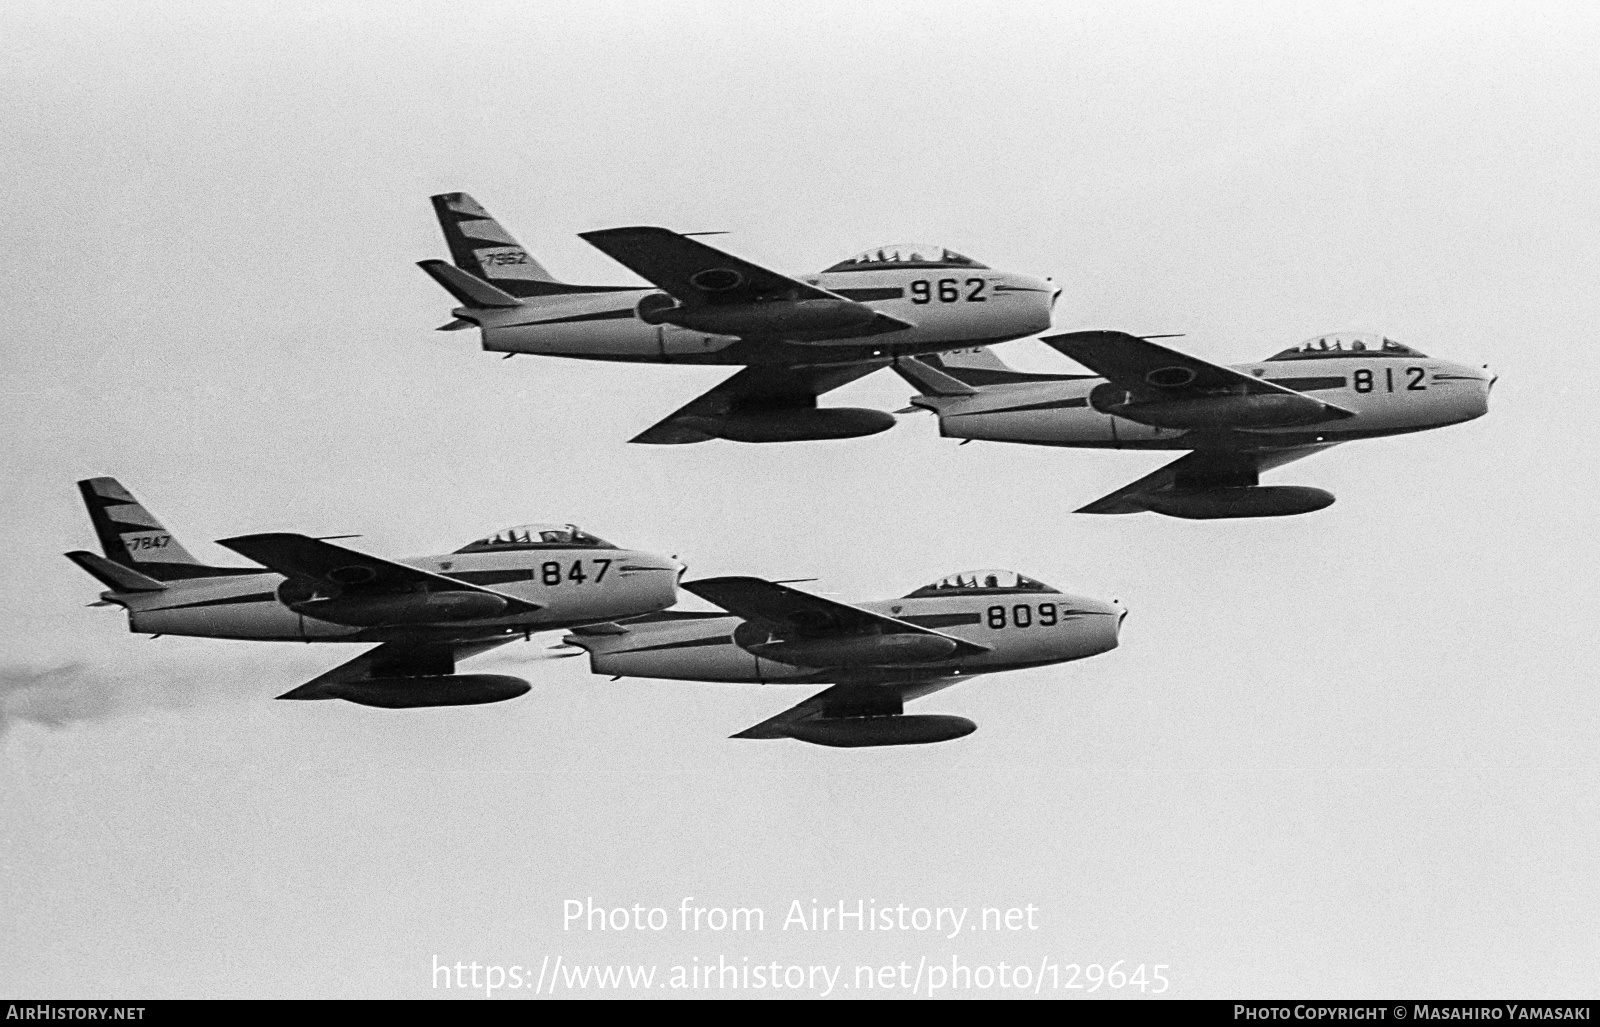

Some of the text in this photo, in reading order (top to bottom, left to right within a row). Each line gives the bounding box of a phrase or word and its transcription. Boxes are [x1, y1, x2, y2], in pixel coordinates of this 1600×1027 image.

[910, 277, 988, 305] 962
[1353, 367, 1428, 394] 812
[540, 558, 613, 587] 847
[986, 602, 1059, 630] 809
